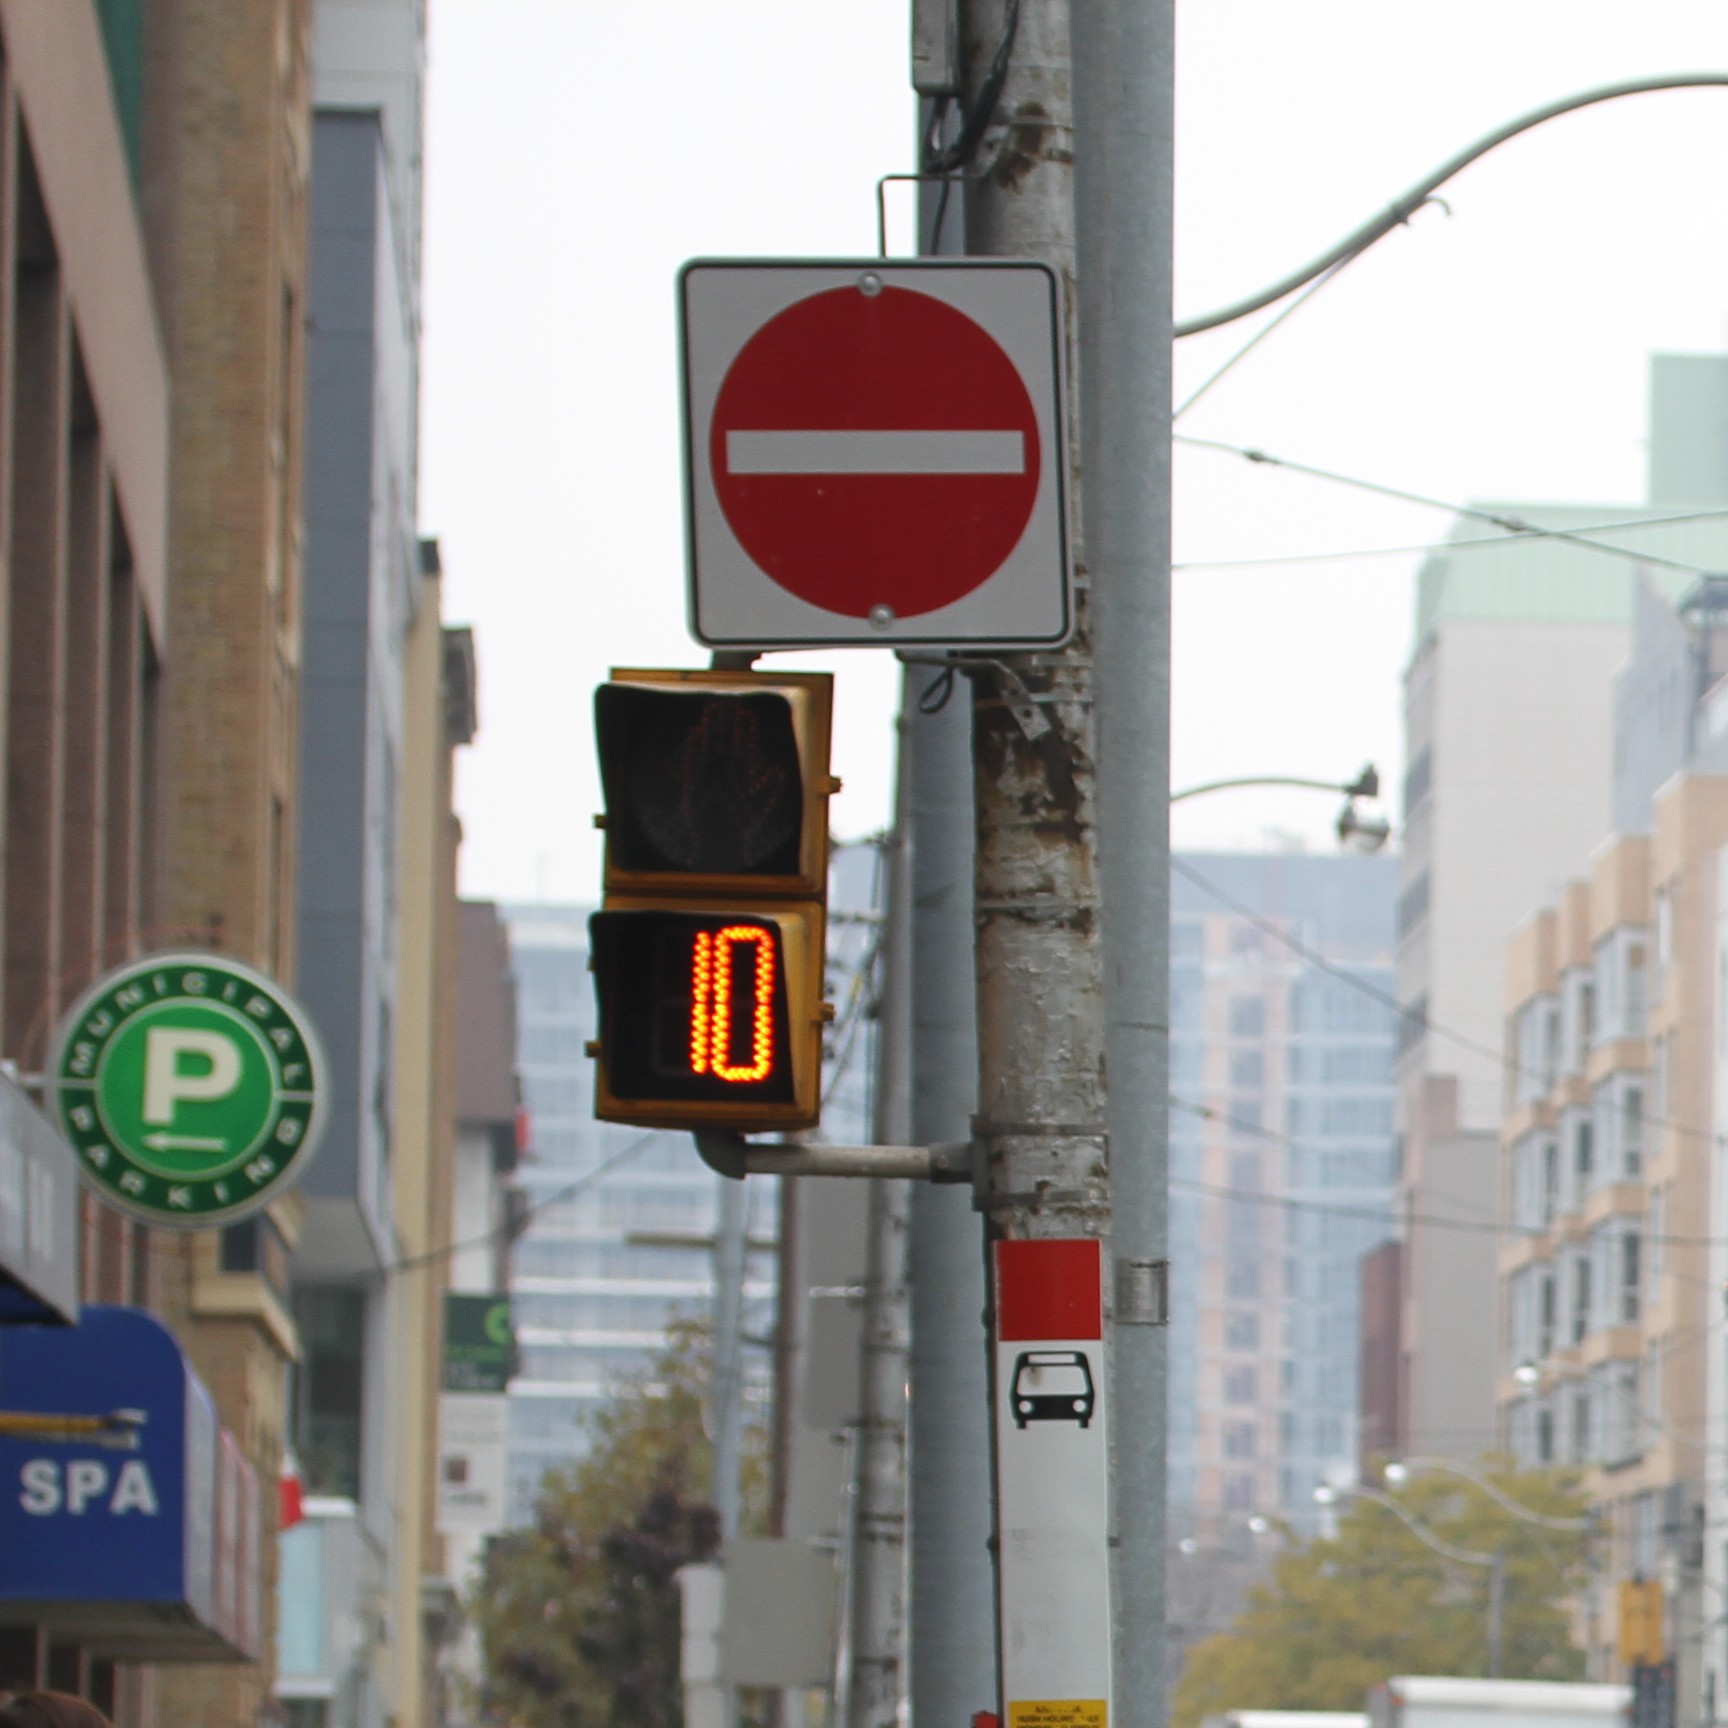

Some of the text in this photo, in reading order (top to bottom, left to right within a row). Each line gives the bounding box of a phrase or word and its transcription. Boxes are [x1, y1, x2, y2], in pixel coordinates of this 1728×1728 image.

[69, 971, 306, 1083] MUNICIPAL
[691, 924, 777, 1082] 10
[143, 1025, 241, 1126] P
[68, 1104, 300, 1210] PARKING
[19, 1457, 159, 1517] SPA
